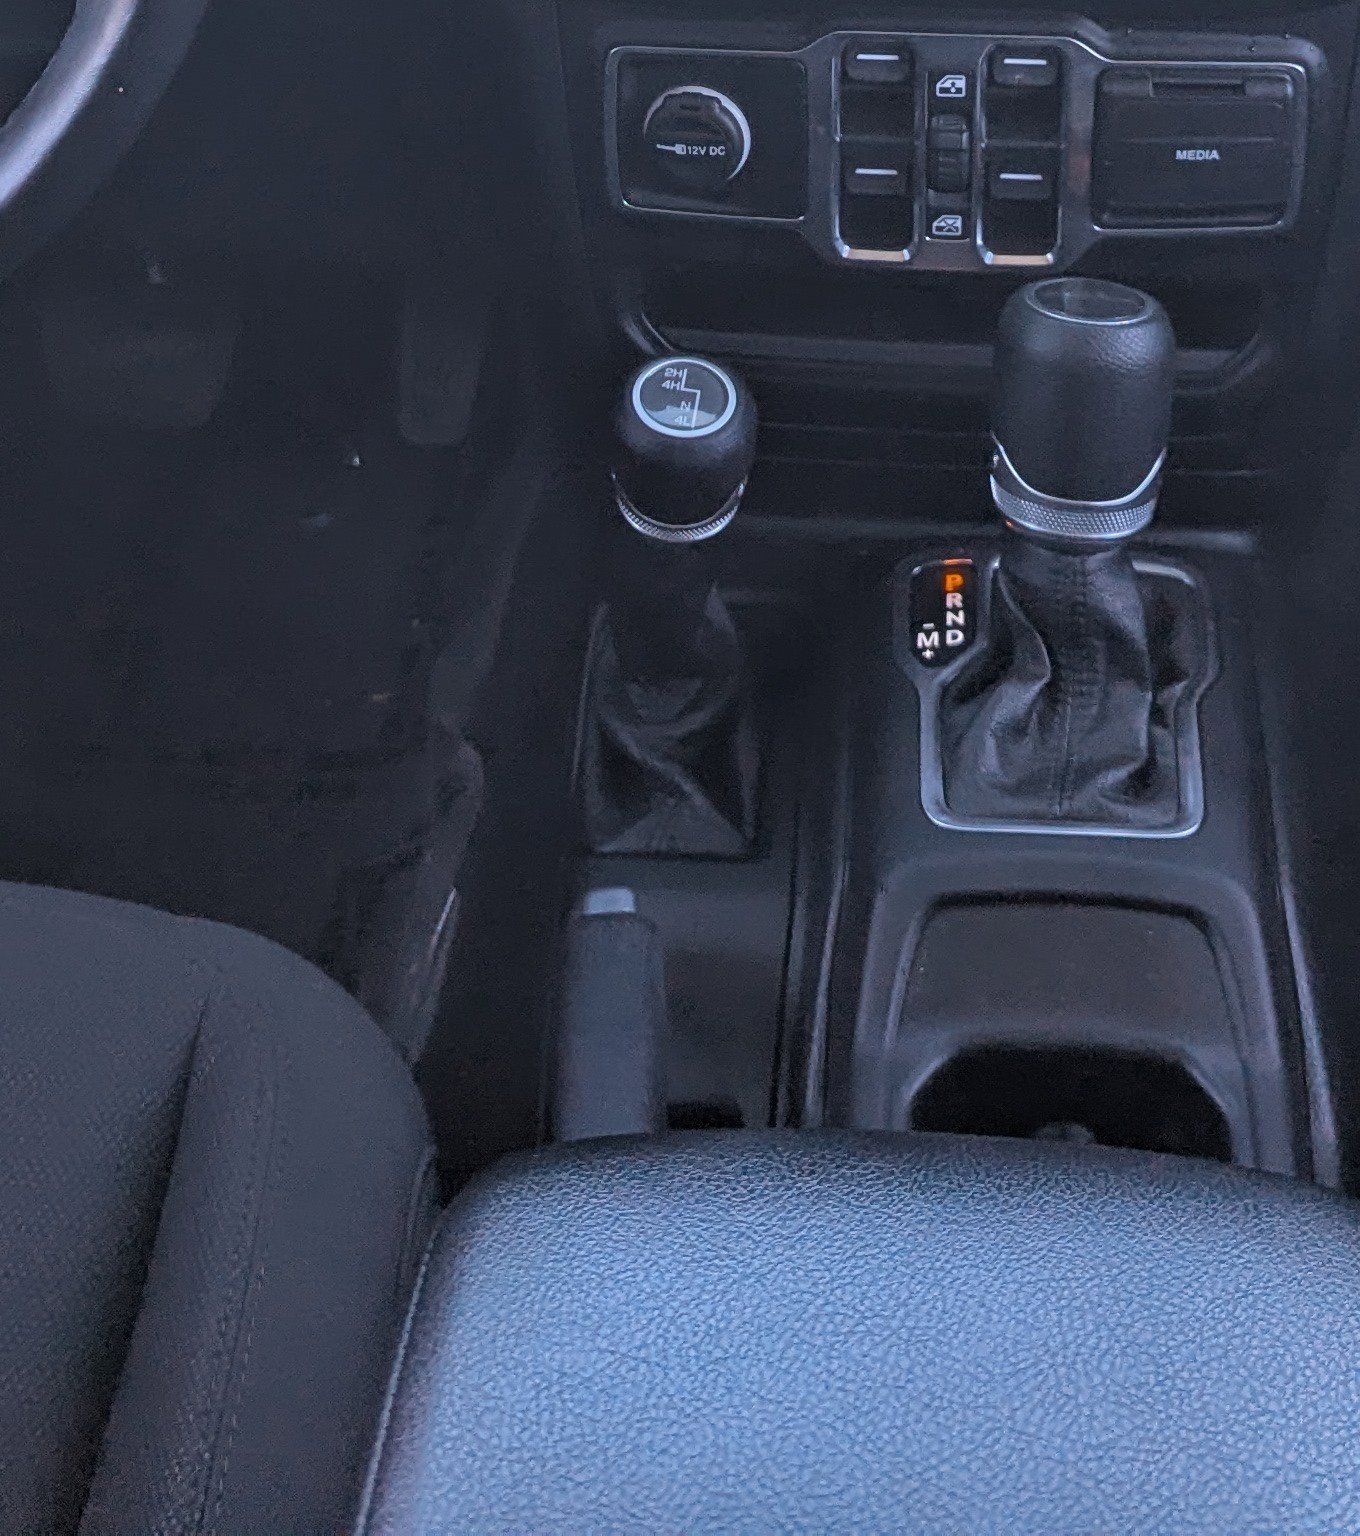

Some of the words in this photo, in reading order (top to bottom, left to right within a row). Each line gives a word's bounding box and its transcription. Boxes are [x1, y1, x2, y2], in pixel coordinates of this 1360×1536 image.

[687, 145, 706, 156] 12V
[709, 145, 726, 156] DC
[1175, 149, 1220, 161] MEDIA
[664, 367, 683, 378] 2H
[661, 379, 681, 391] 4H
[680, 400, 692, 411] N
[944, 574, 964, 592] P
[945, 592, 963, 609] R
[945, 610, 965, 626] N
[916, 631, 940, 649] M
[945, 629, 965, 646] D
